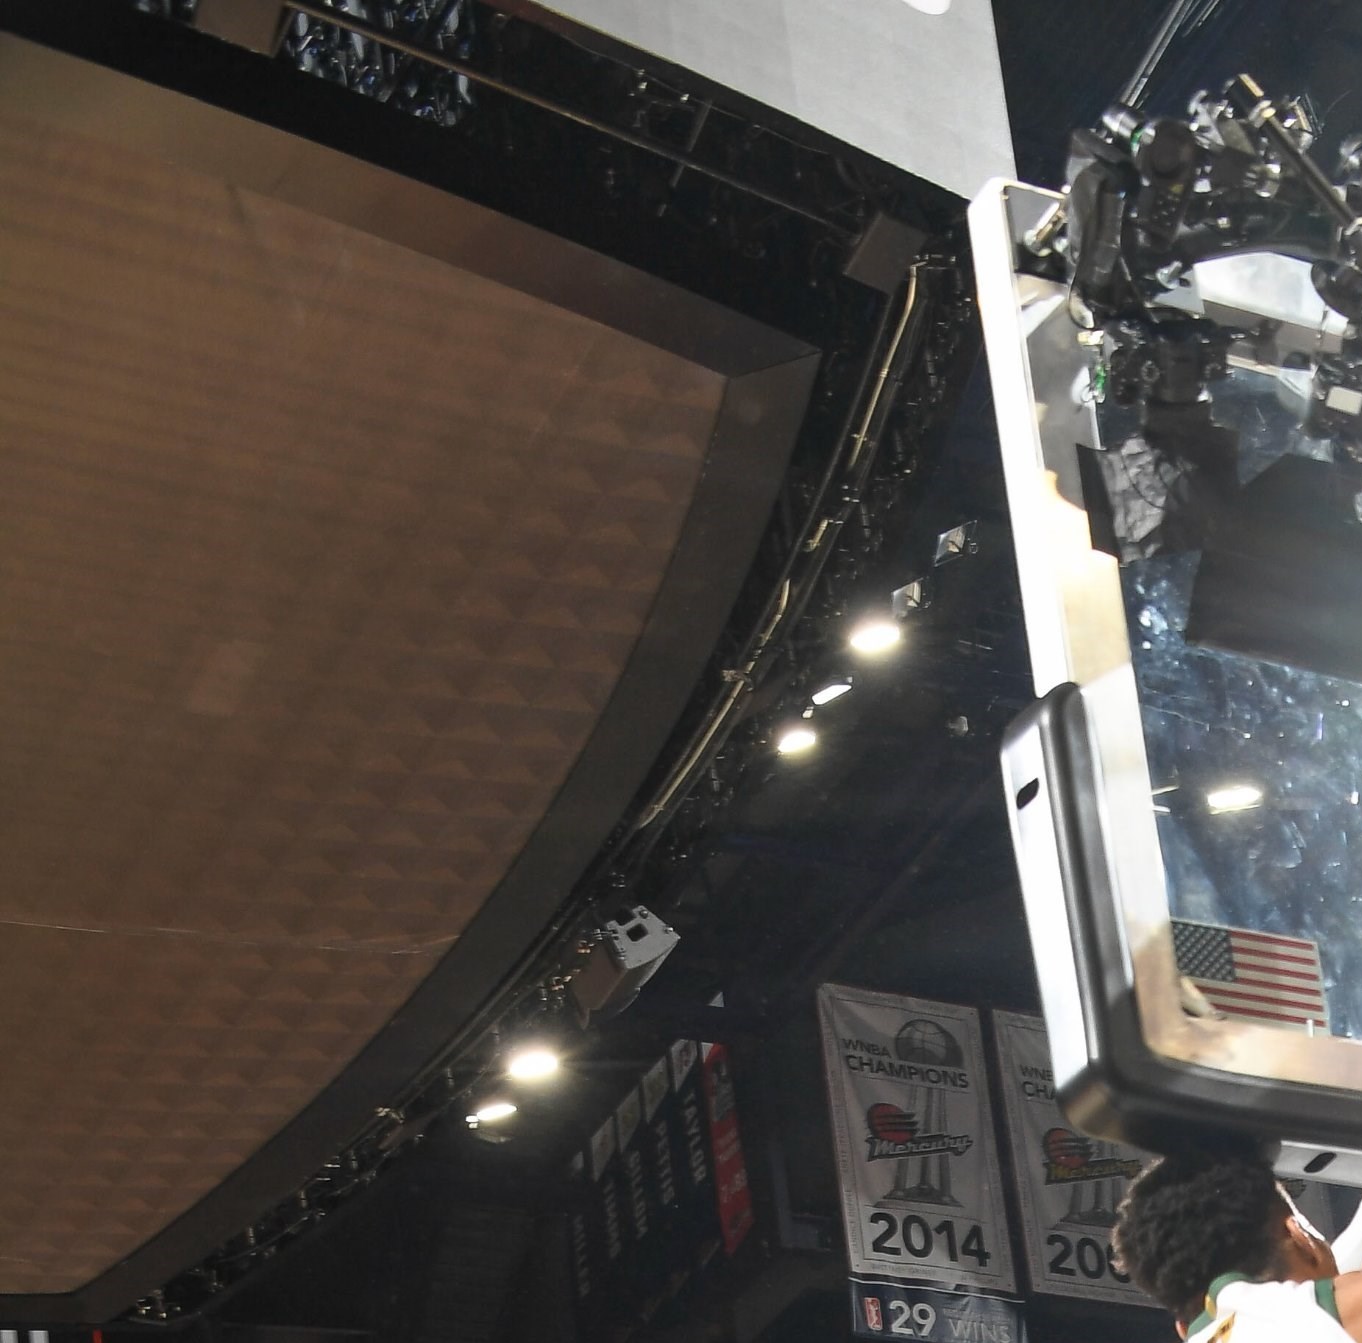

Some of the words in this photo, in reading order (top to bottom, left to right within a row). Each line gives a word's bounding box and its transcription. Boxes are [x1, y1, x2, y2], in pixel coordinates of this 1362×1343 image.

[842, 1038, 892, 1059] WNBA
[846, 1055, 969, 1088] CHAMPIONS
[1020, 1064, 1054, 1082] WNB
[870, 1212, 991, 1267] 2014
[1047, 1233, 1131, 1284] 20
[889, 1300, 936, 1337] 29
